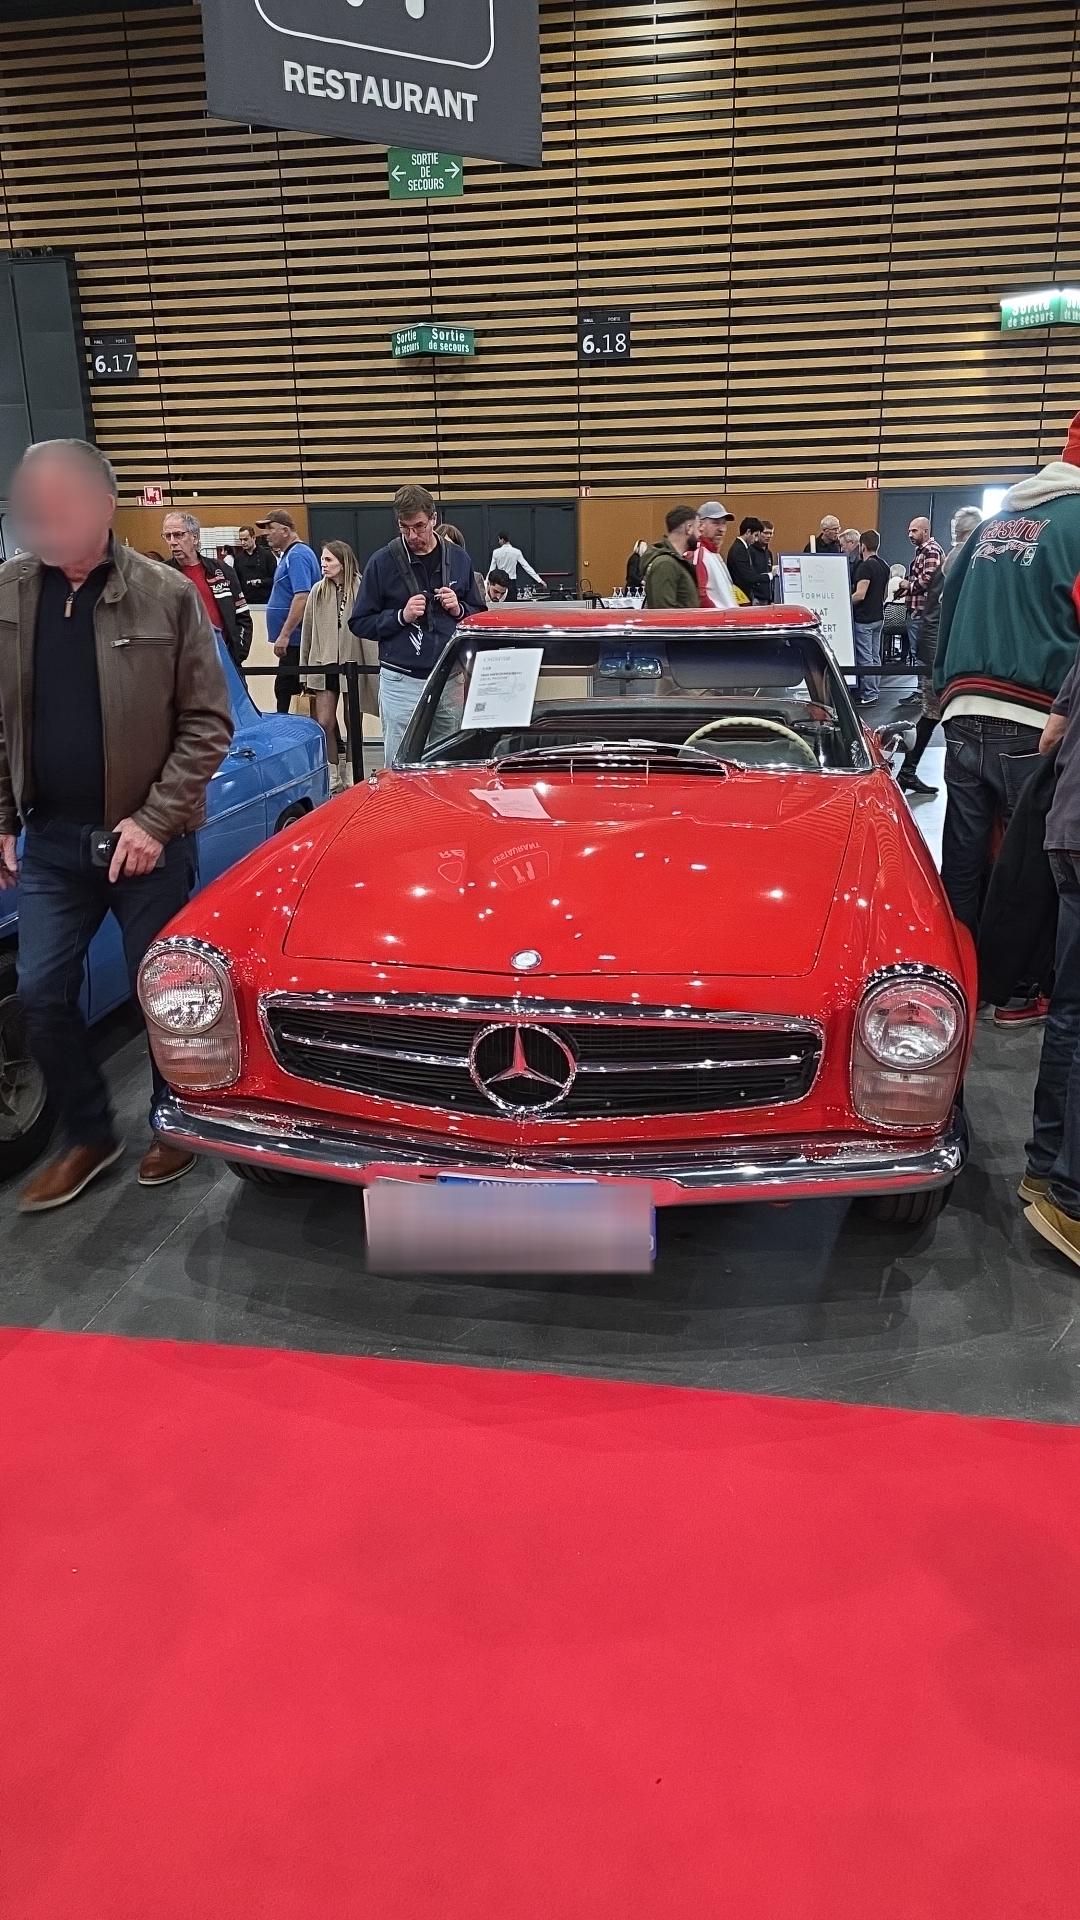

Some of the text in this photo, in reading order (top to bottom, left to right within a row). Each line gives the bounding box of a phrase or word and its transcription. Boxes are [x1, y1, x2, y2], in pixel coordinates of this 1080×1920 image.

[283, 60, 478, 122] RESTAURANT
[411, 152, 439, 166] SORTIE
[420, 165, 431, 178] DE
[407, 178, 445, 191] SECOURS
[1007, 311, 1054, 328] de secours
[396, 329, 417, 345] Sortie
[431, 328, 465, 342] Sortie
[428, 340, 470, 353] de secours
[582, 333, 627, 354] 6.18
[95, 354, 133, 373] 6.17
[980, 517, 1051, 541] Castrol
[801, 592, 835, 600] FORMULE
